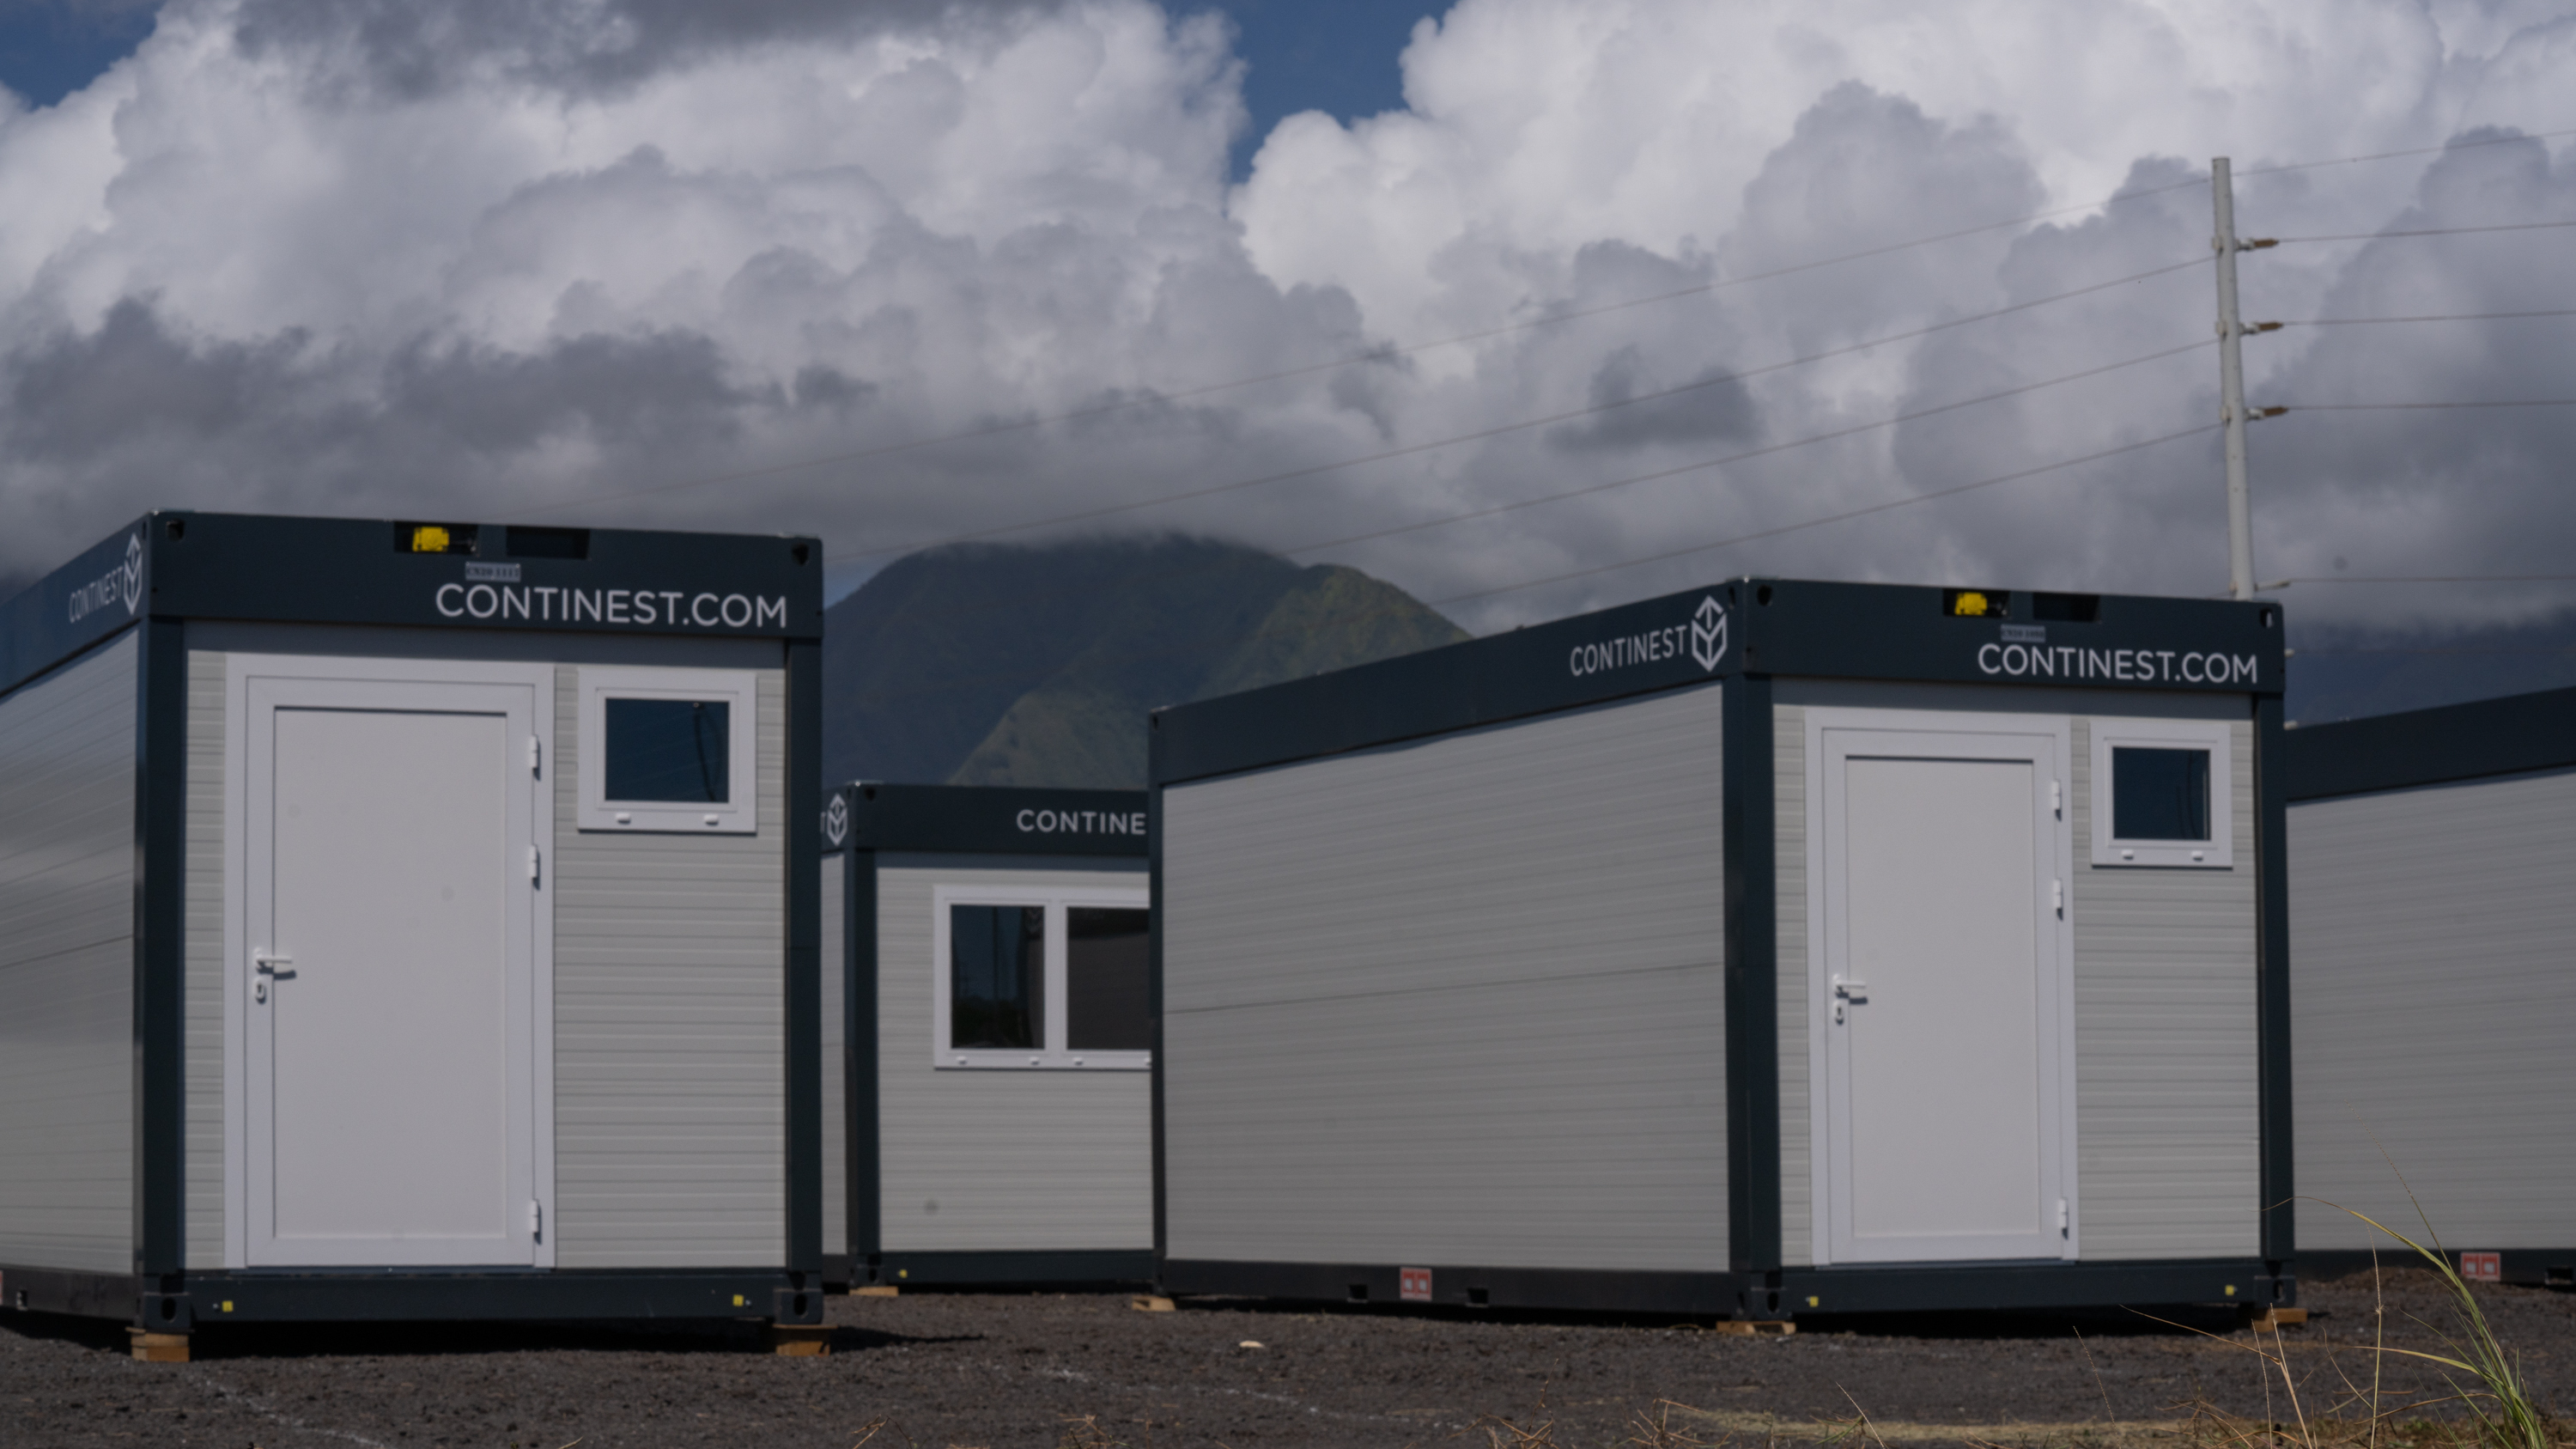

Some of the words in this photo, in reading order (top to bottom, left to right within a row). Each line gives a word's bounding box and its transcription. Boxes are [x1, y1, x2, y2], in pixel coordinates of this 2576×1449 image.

[69, 566, 123, 624] CONTINEST
[436, 583, 787, 628] CONTINEST.COM
[1570, 624, 1688, 677] CONTINEST
[1978, 642, 2257, 684] CONTINEST.COM
[1017, 809, 1146, 835] CONTINE
